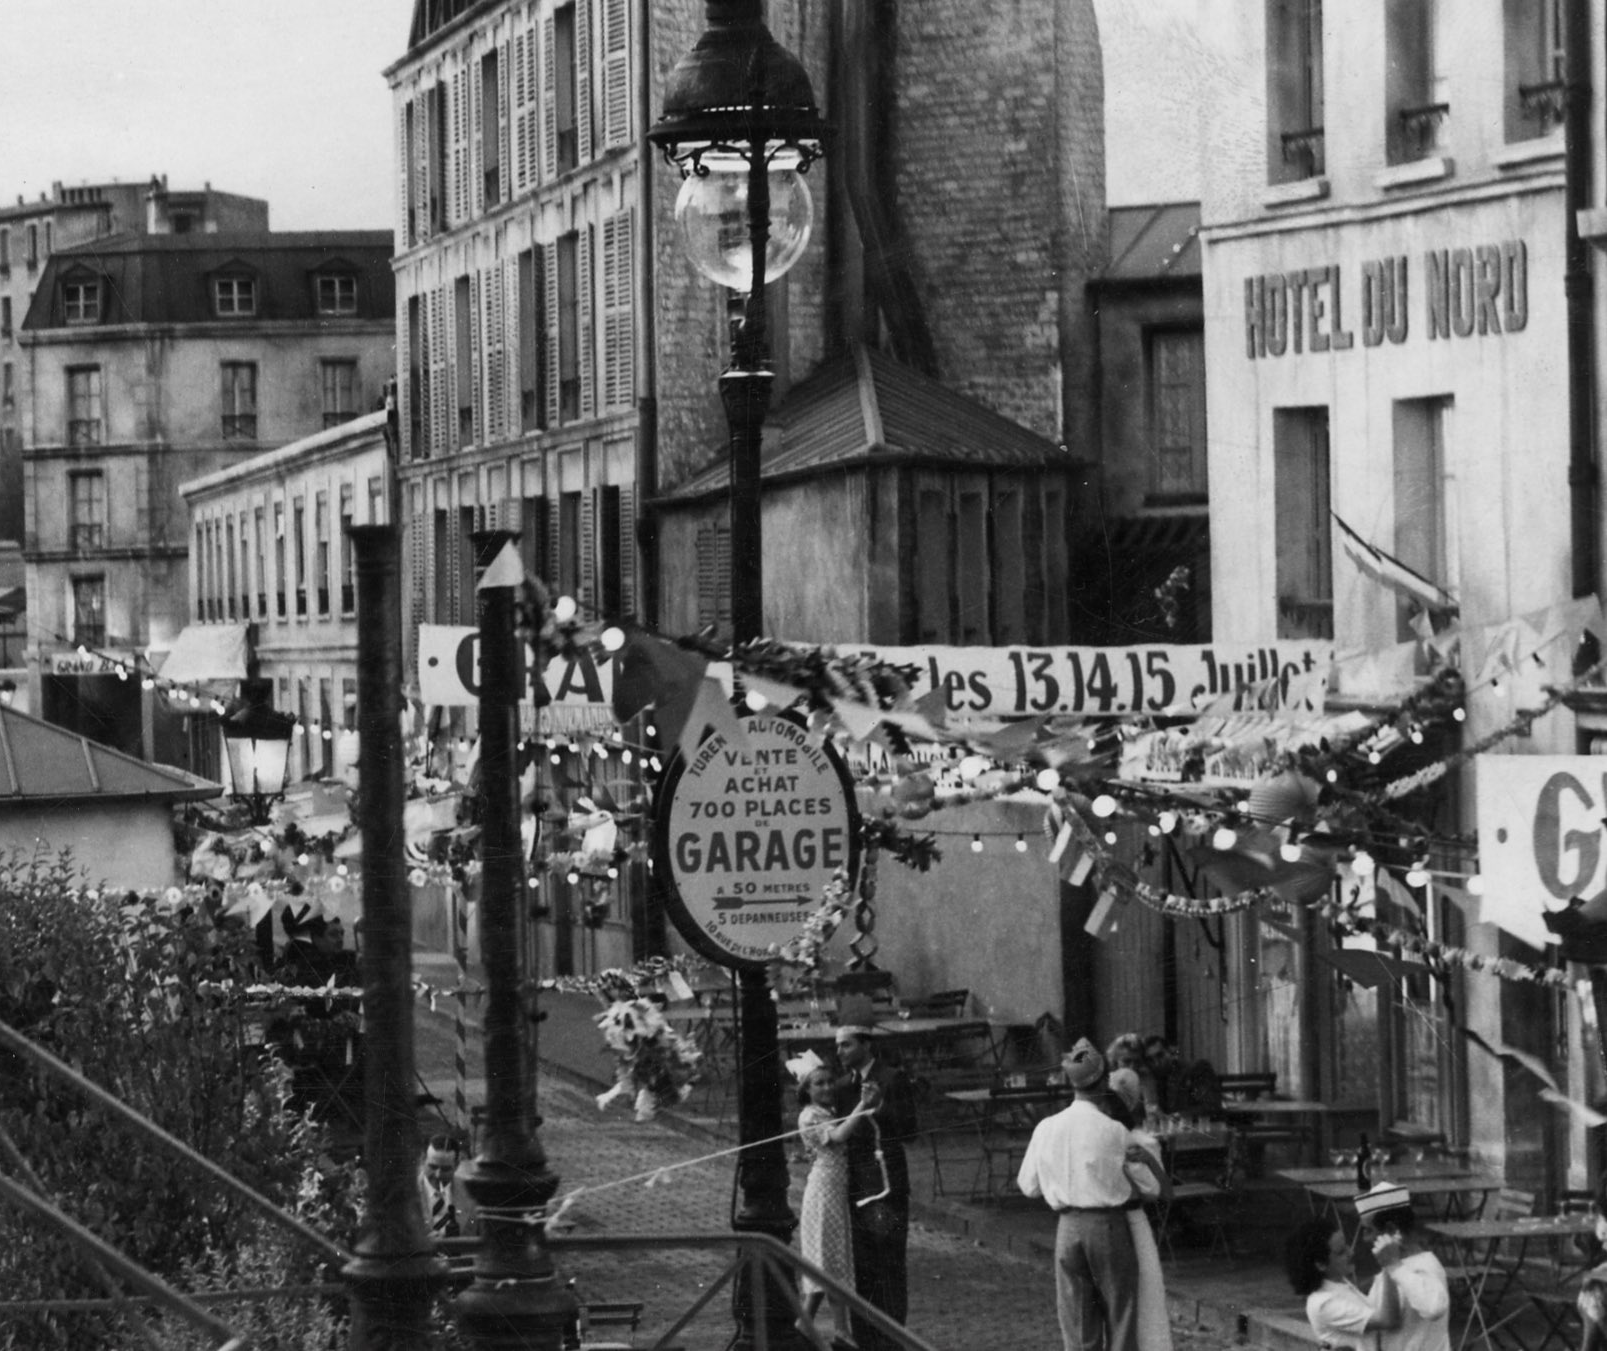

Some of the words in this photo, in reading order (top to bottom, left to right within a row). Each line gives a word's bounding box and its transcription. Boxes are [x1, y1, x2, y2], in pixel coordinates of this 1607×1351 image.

[1244, 264, 1353, 360] HOTEL
[1361, 255, 1408, 347] DU
[1424, 239, 1528, 341] NORD
[1008, 651, 1175, 712] 13.14.15
[1191, 648, 1317, 712] Juillet
[689, 734, 728, 778] TUREN
[724, 749, 798, 766] VENTE
[754, 767, 769, 775] ET
[724, 776, 799, 794] ACHAT
[690, 801, 736, 818] 700
[745, 798, 832, 817] PLACES
[754, 819, 770, 828] DE
[1533, 772, 1607, 900] G
[676, 828, 843, 874] GARAGE
[733, 882, 757, 895] 50
[718, 912, 727, 925] 5
